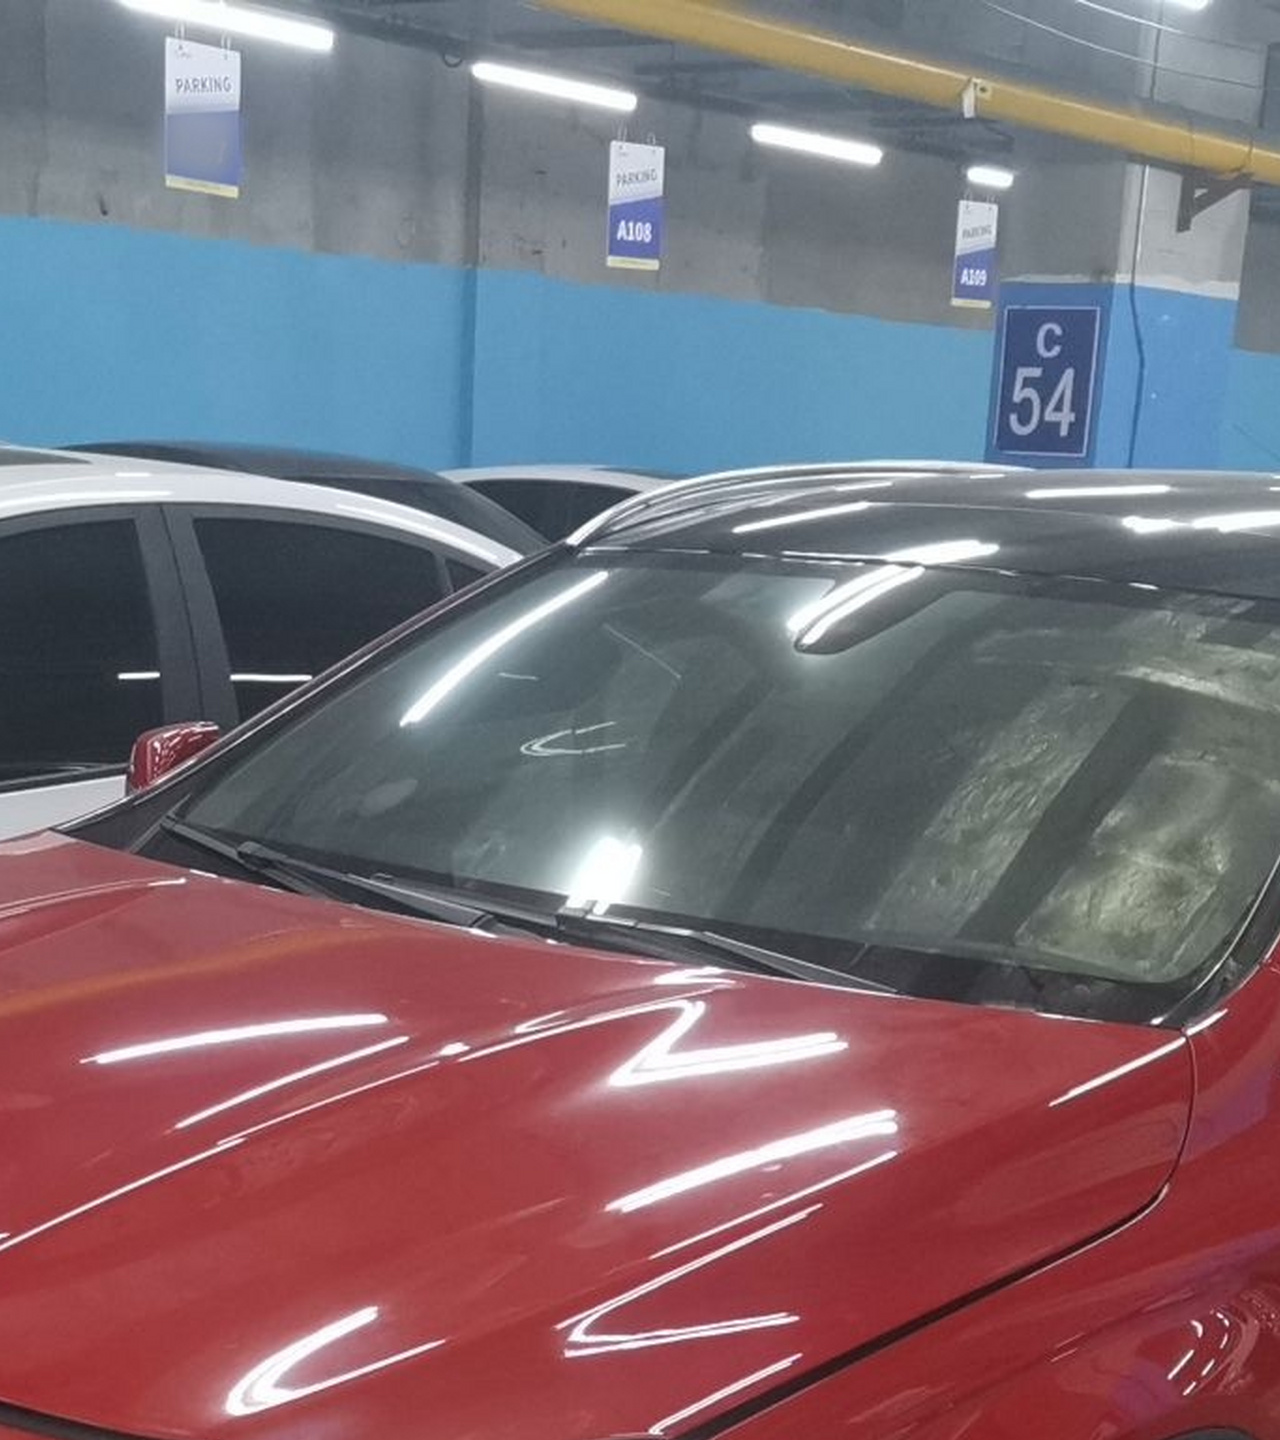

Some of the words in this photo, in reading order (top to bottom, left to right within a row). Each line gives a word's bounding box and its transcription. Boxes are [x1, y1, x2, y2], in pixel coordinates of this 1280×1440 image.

[175, 75, 232, 94] PARKING
[616, 168, 658, 187] PARKING
[616, 220, 652, 243] A108
[1036, 322, 1063, 358] C
[1009, 366, 1076, 437] 54
